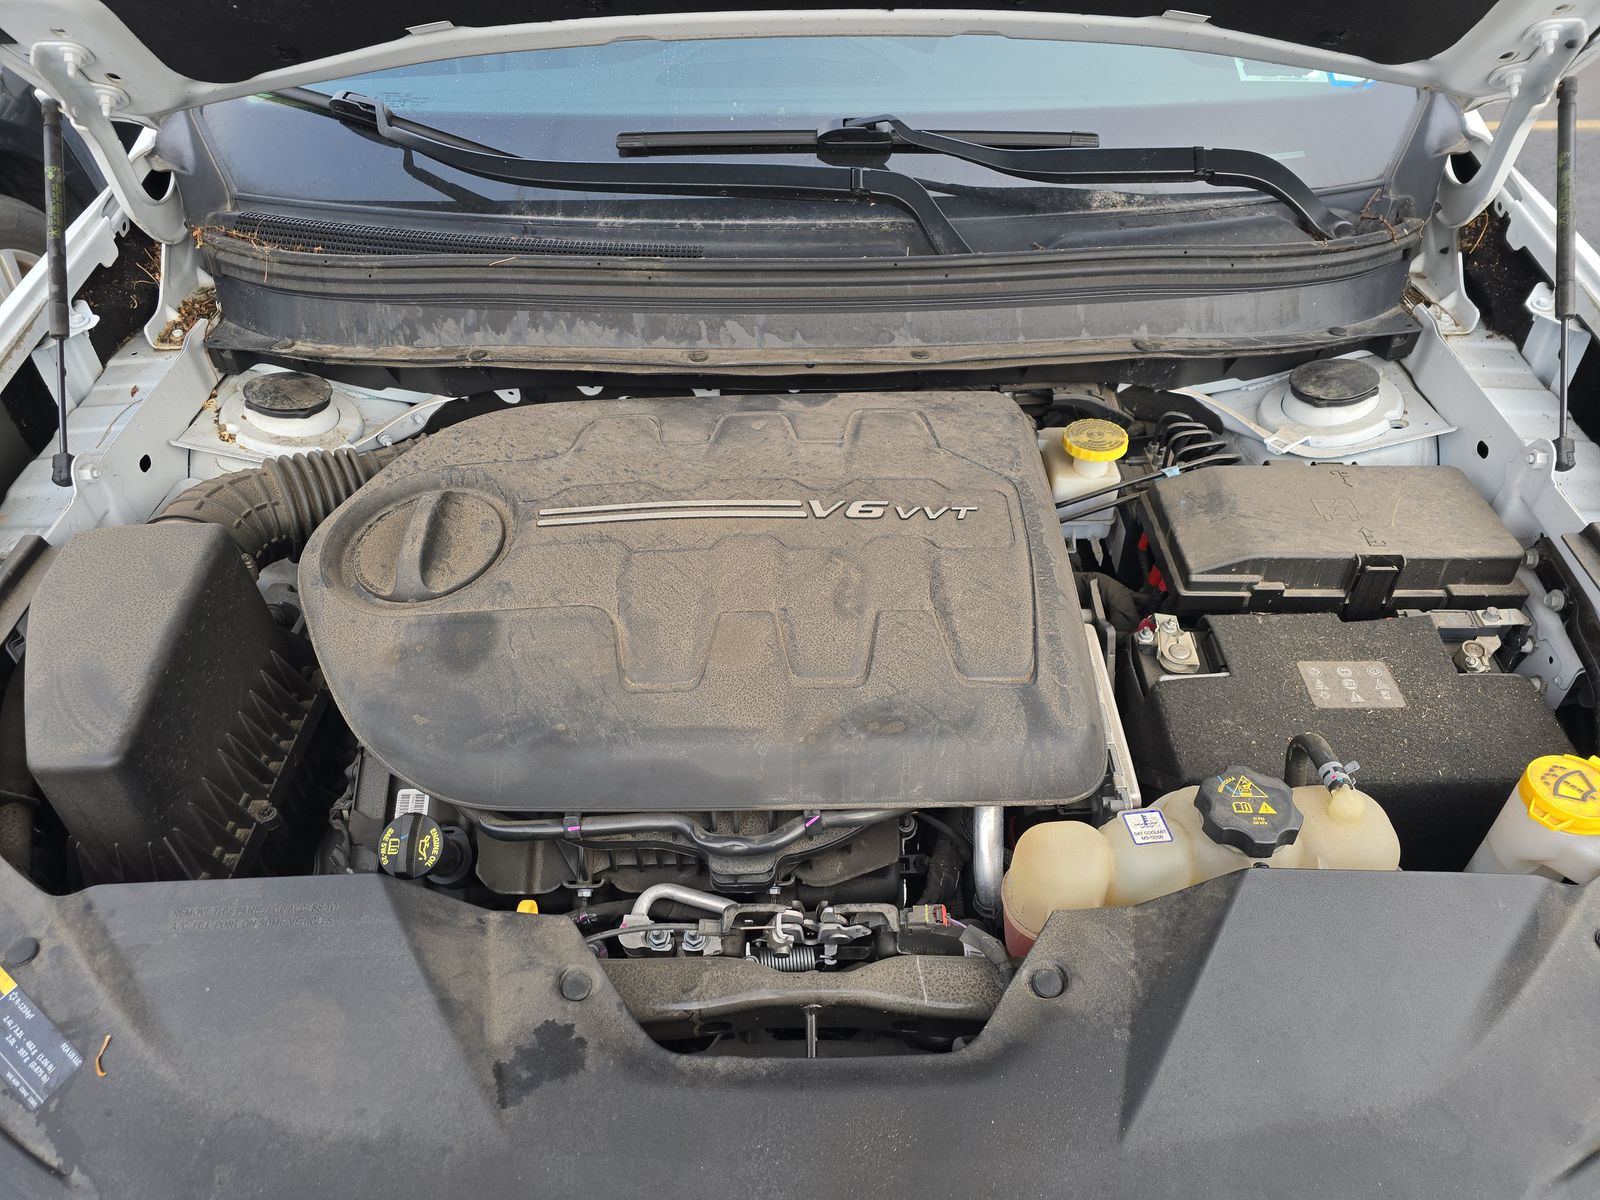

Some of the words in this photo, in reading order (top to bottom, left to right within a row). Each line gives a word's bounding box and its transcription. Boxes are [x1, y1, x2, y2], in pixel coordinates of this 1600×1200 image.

[807, 500, 889, 519] V6
[895, 507, 978, 520] VVT
[383, 827, 394, 842] SAE
[430, 828, 440, 855] ENGINE
[380, 843, 389, 866] 5W-20
[425, 856, 436, 867] OIL
[174, 908, 208, 917] REMOVE
[215, 906, 234, 916] THIS
[237, 904, 264, 915] PANEL
[268, 904, 285, 914] FOR
[215, 920, 238, 929] PORT
[242, 919, 257, 928] ON
[290, 916, 333, 926] VEHICLES
[15, 998, 35, 1020] R-1234yf
[60, 1042, 70, 1053] FCA
